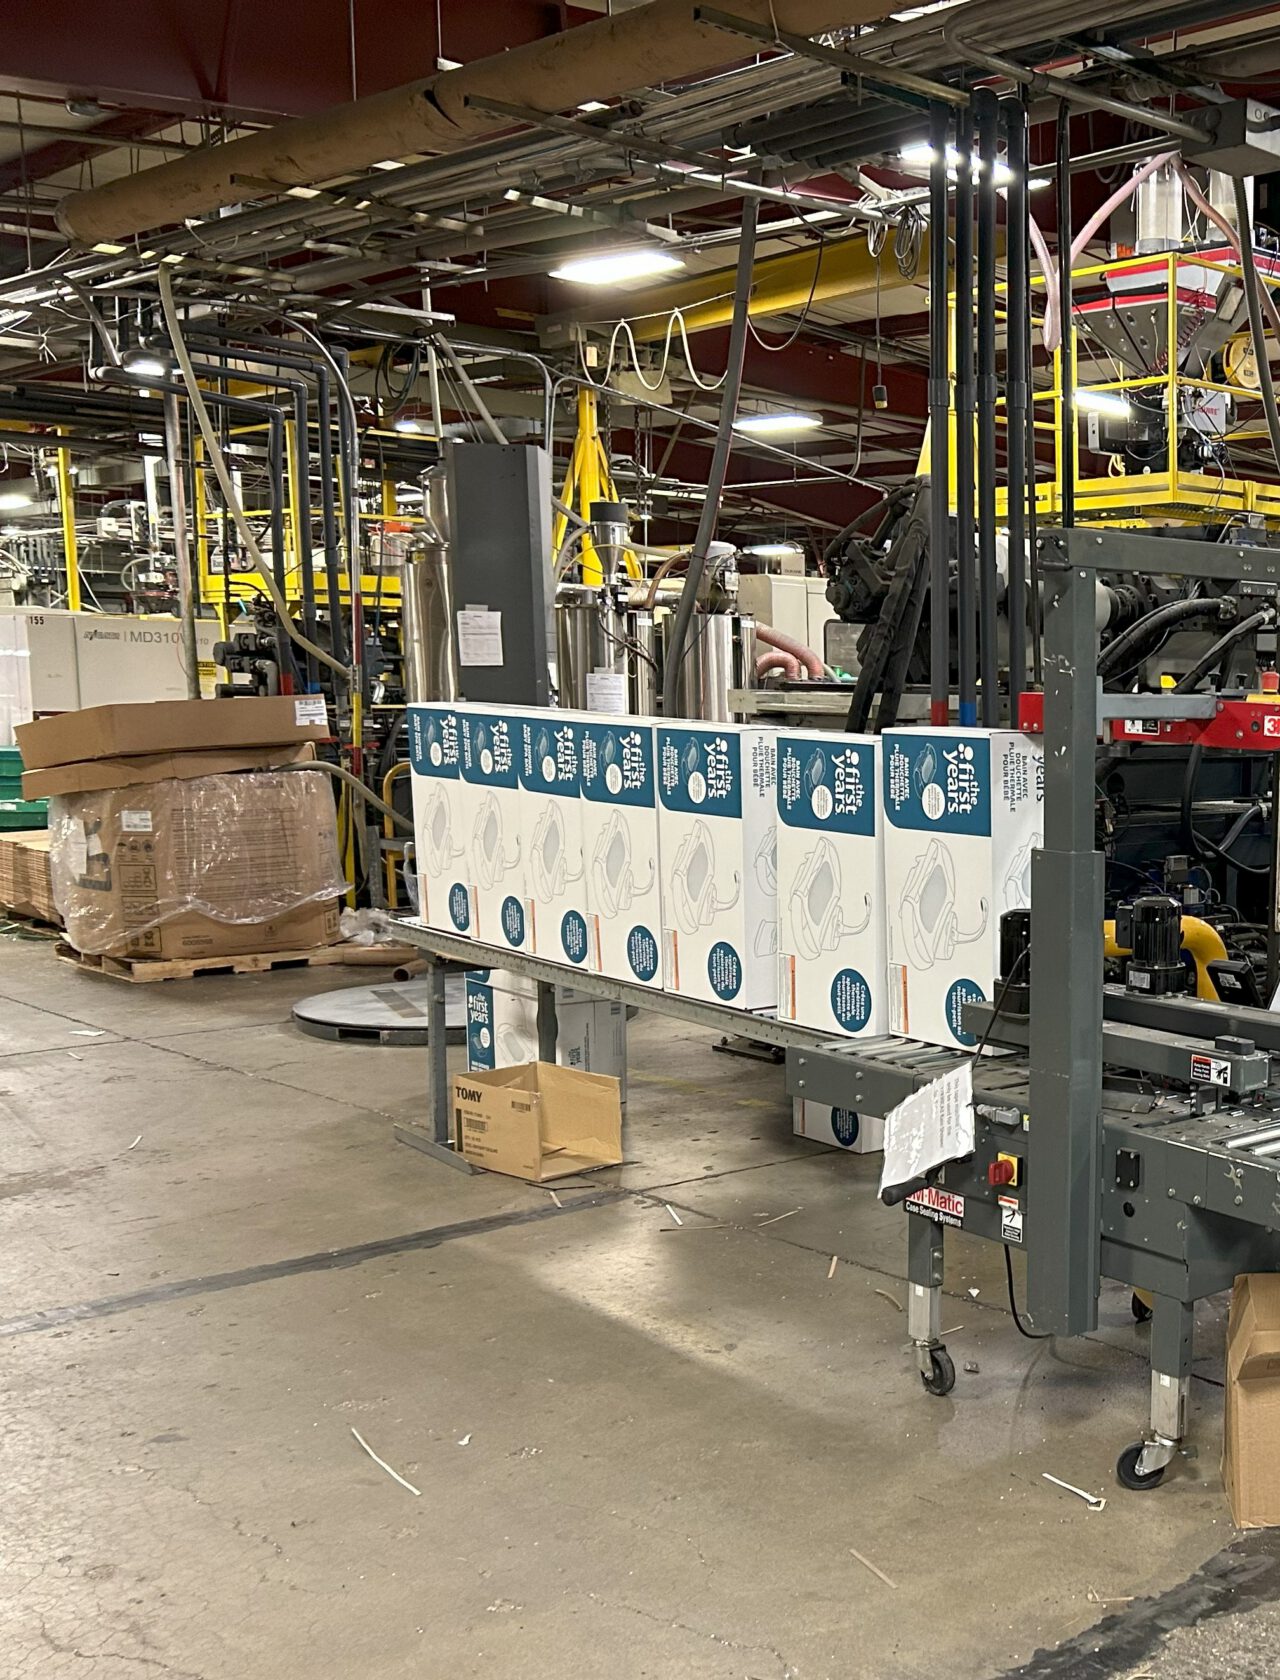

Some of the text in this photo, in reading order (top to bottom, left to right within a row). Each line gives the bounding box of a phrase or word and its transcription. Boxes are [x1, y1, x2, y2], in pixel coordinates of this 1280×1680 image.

[30, 616, 44, 625] 155
[490, 725, 501, 773] years
[500, 735, 510, 773] first
[554, 731, 564, 781] years
[564, 742, 575, 781] first
[620, 736, 631, 789] years
[631, 748, 642, 789] first
[704, 743, 717, 799] years
[716, 754, 729, 799] first
[831, 754, 845, 814] years
[846, 767, 860, 815] first
[943, 750, 959, 813] years
[959, 763, 975, 814] first
[1032, 755, 1044, 802] years
[856, 785, 865, 807] the
[971, 781, 981, 805] the
[470, 1010, 489, 1024] years
[474, 998, 489, 1014] first
[455, 1086, 483, 1103] TOMY
[906, 1202, 962, 1227] Case Sealing Systems
